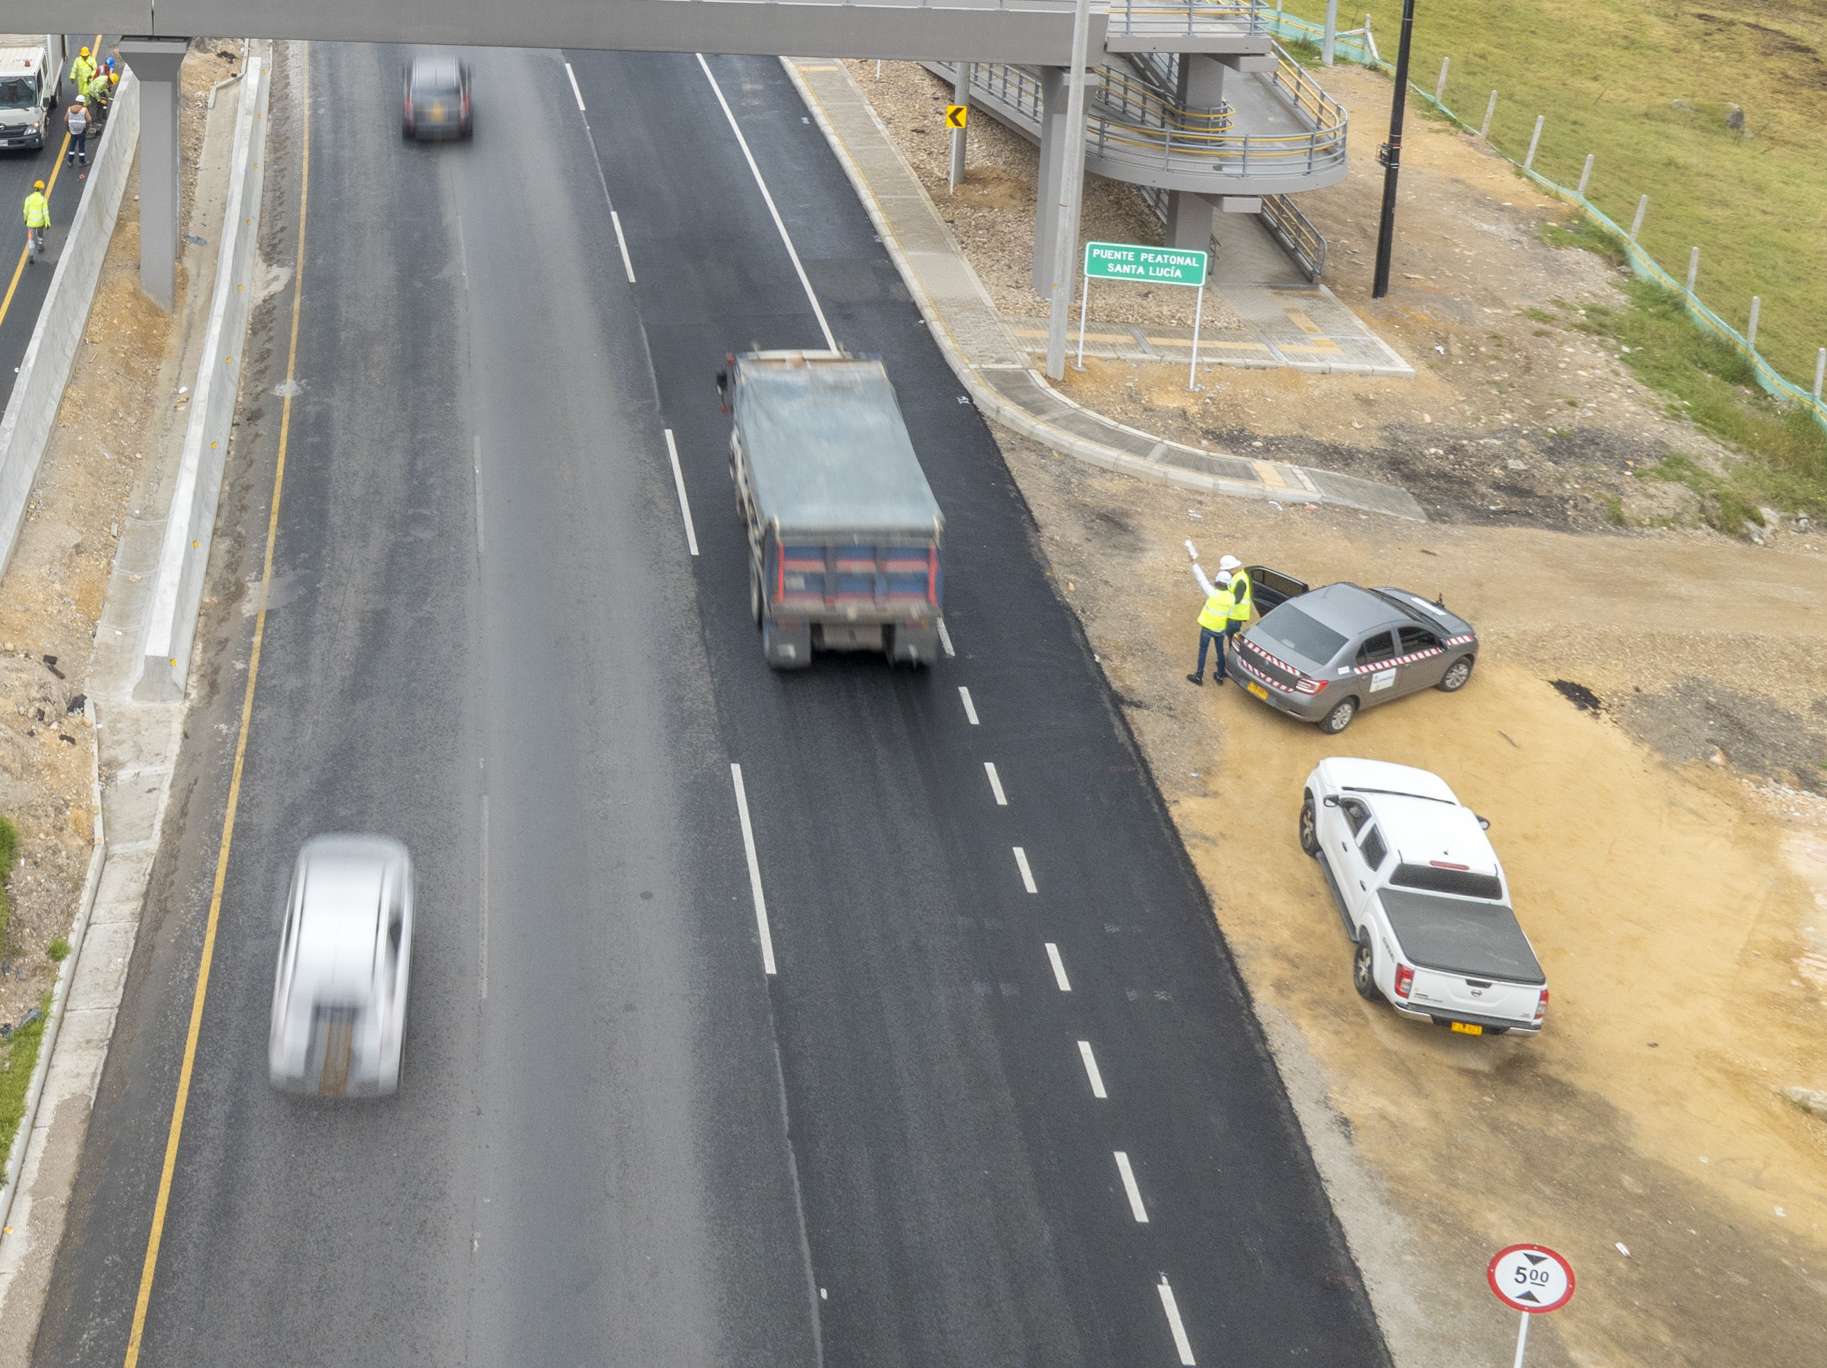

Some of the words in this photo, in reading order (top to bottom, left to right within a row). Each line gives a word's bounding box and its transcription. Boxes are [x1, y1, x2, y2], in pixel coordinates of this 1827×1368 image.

[1093, 248, 1135, 261] PUENTE
[1140, 253, 1199, 266] PEATONAL
[1107, 263, 1145, 275] SANTA
[1149, 266, 1182, 278] LUCÍA
